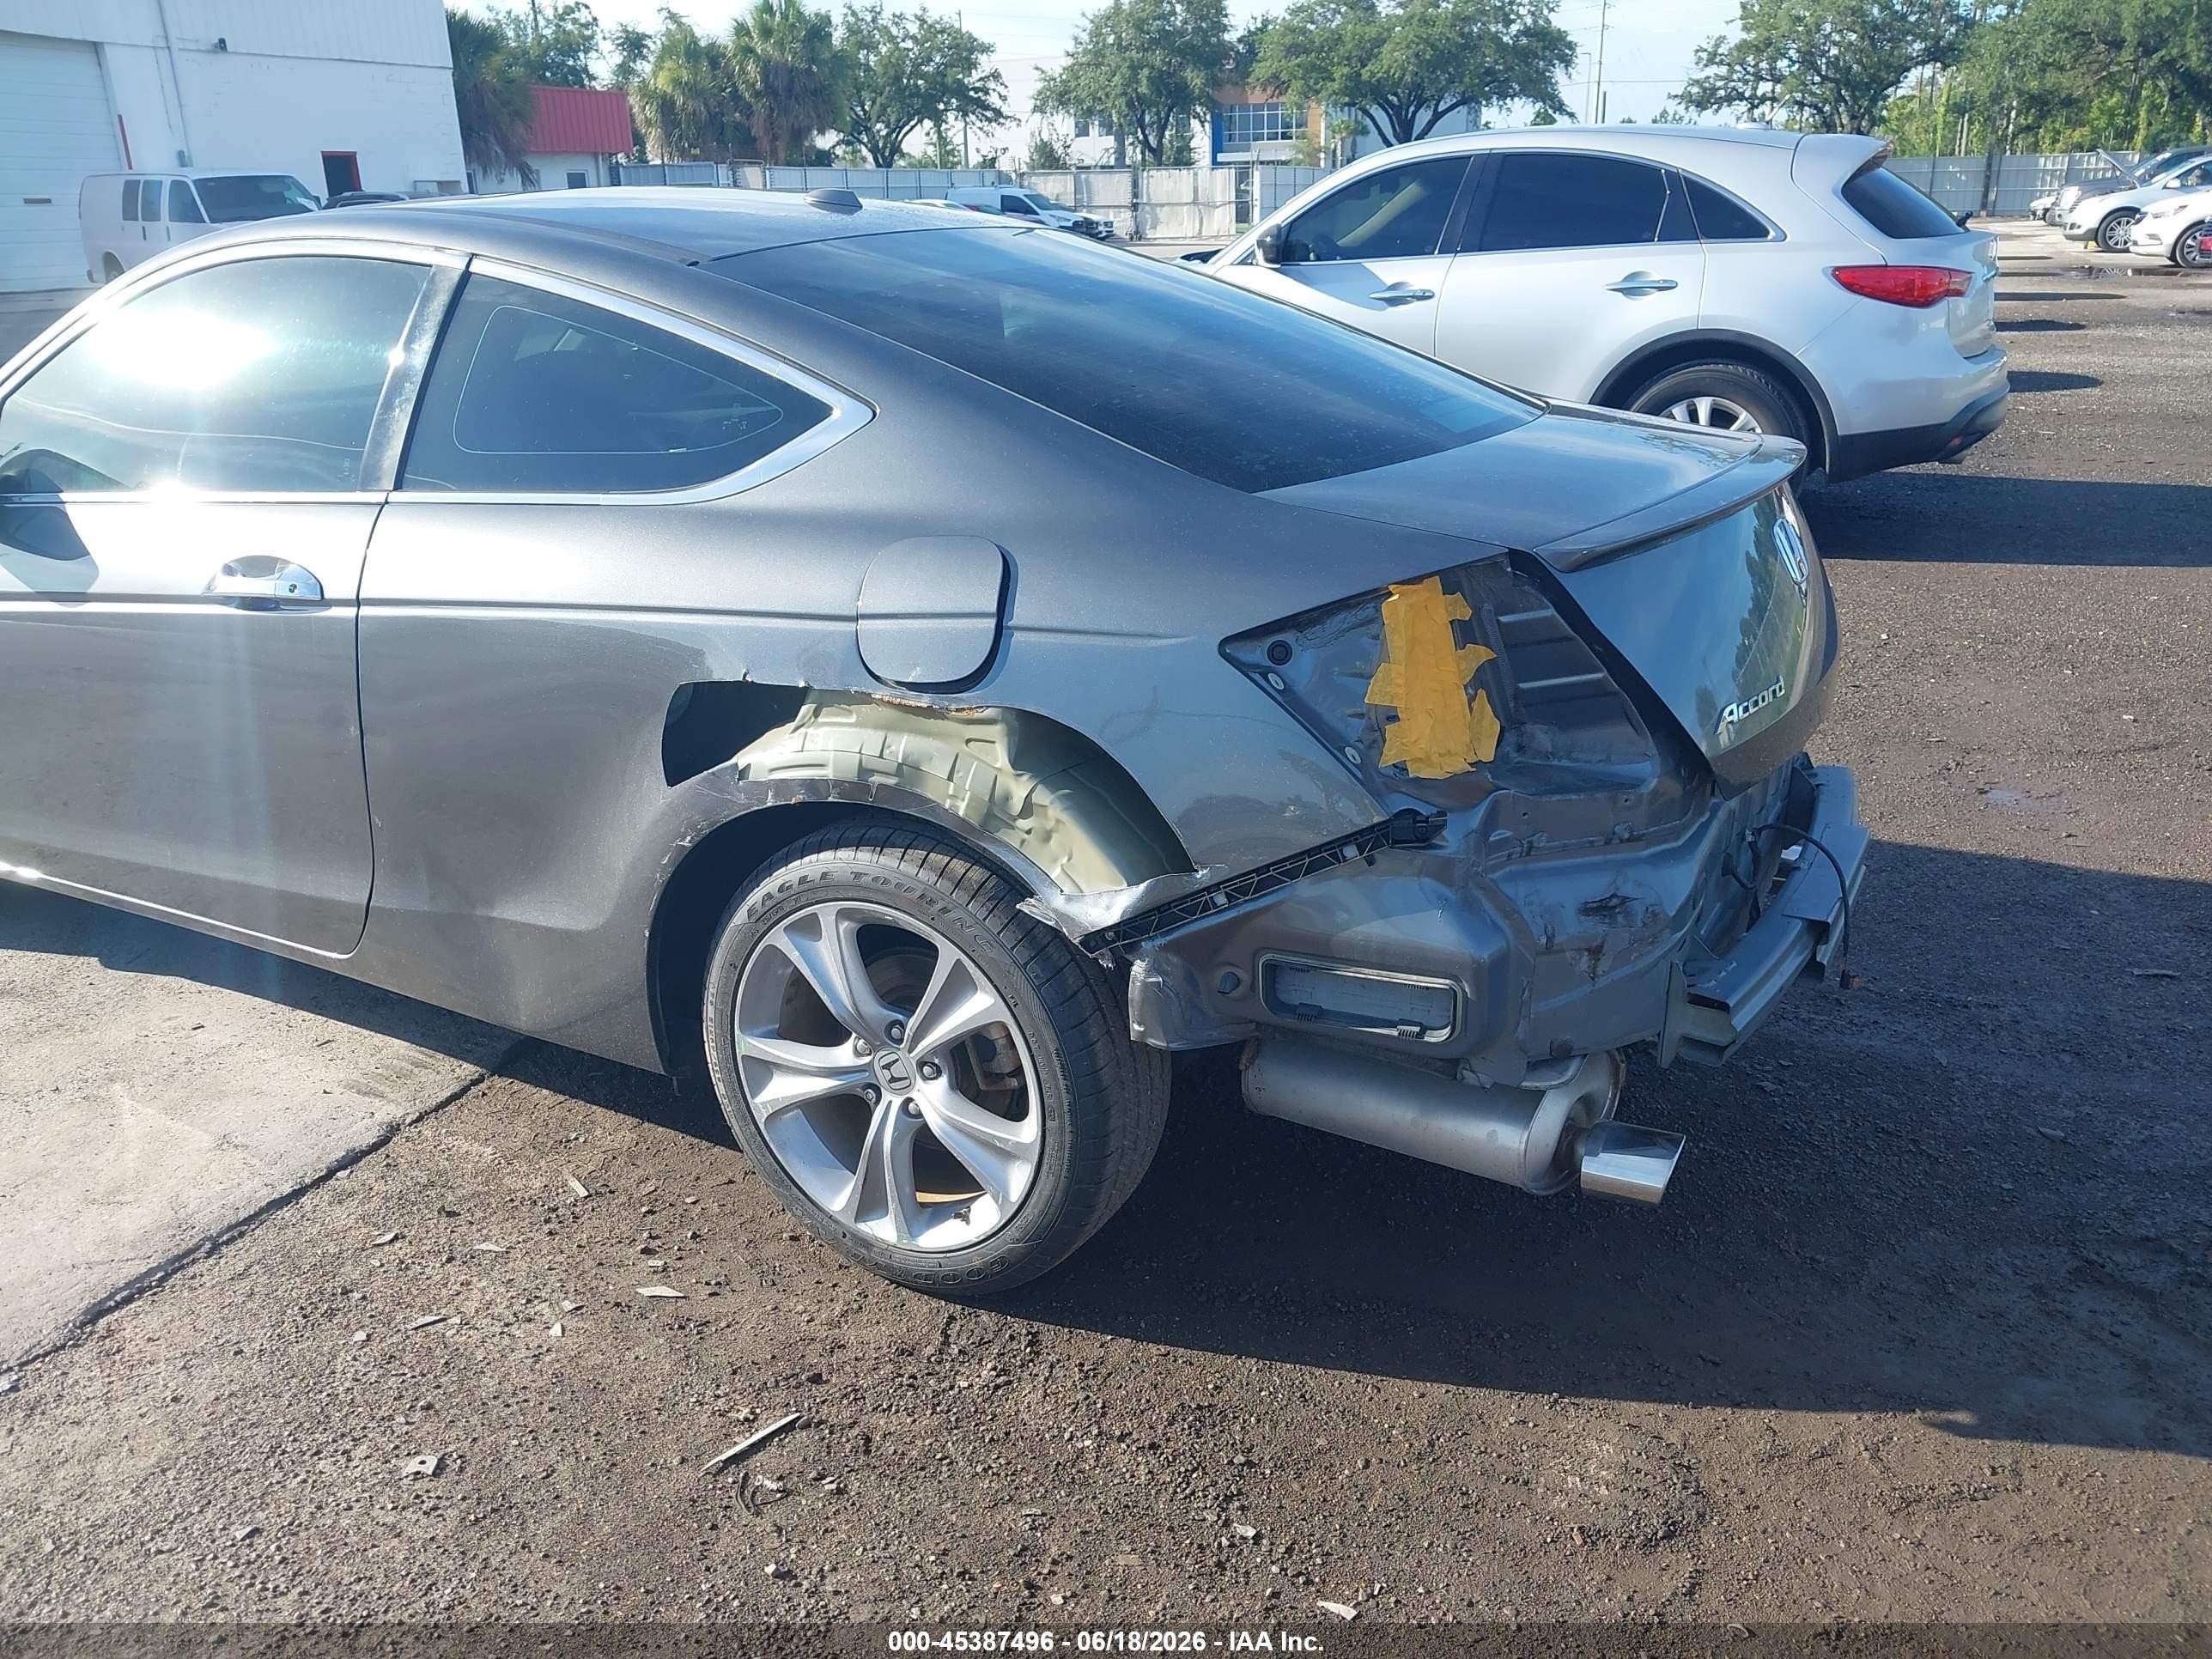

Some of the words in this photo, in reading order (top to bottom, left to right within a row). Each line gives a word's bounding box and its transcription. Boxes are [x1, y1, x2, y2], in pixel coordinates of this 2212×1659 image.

[1714, 675, 1785, 735] Accord
[746, 871, 839, 922] EAGLE
[850, 871, 997, 955] TOURING
